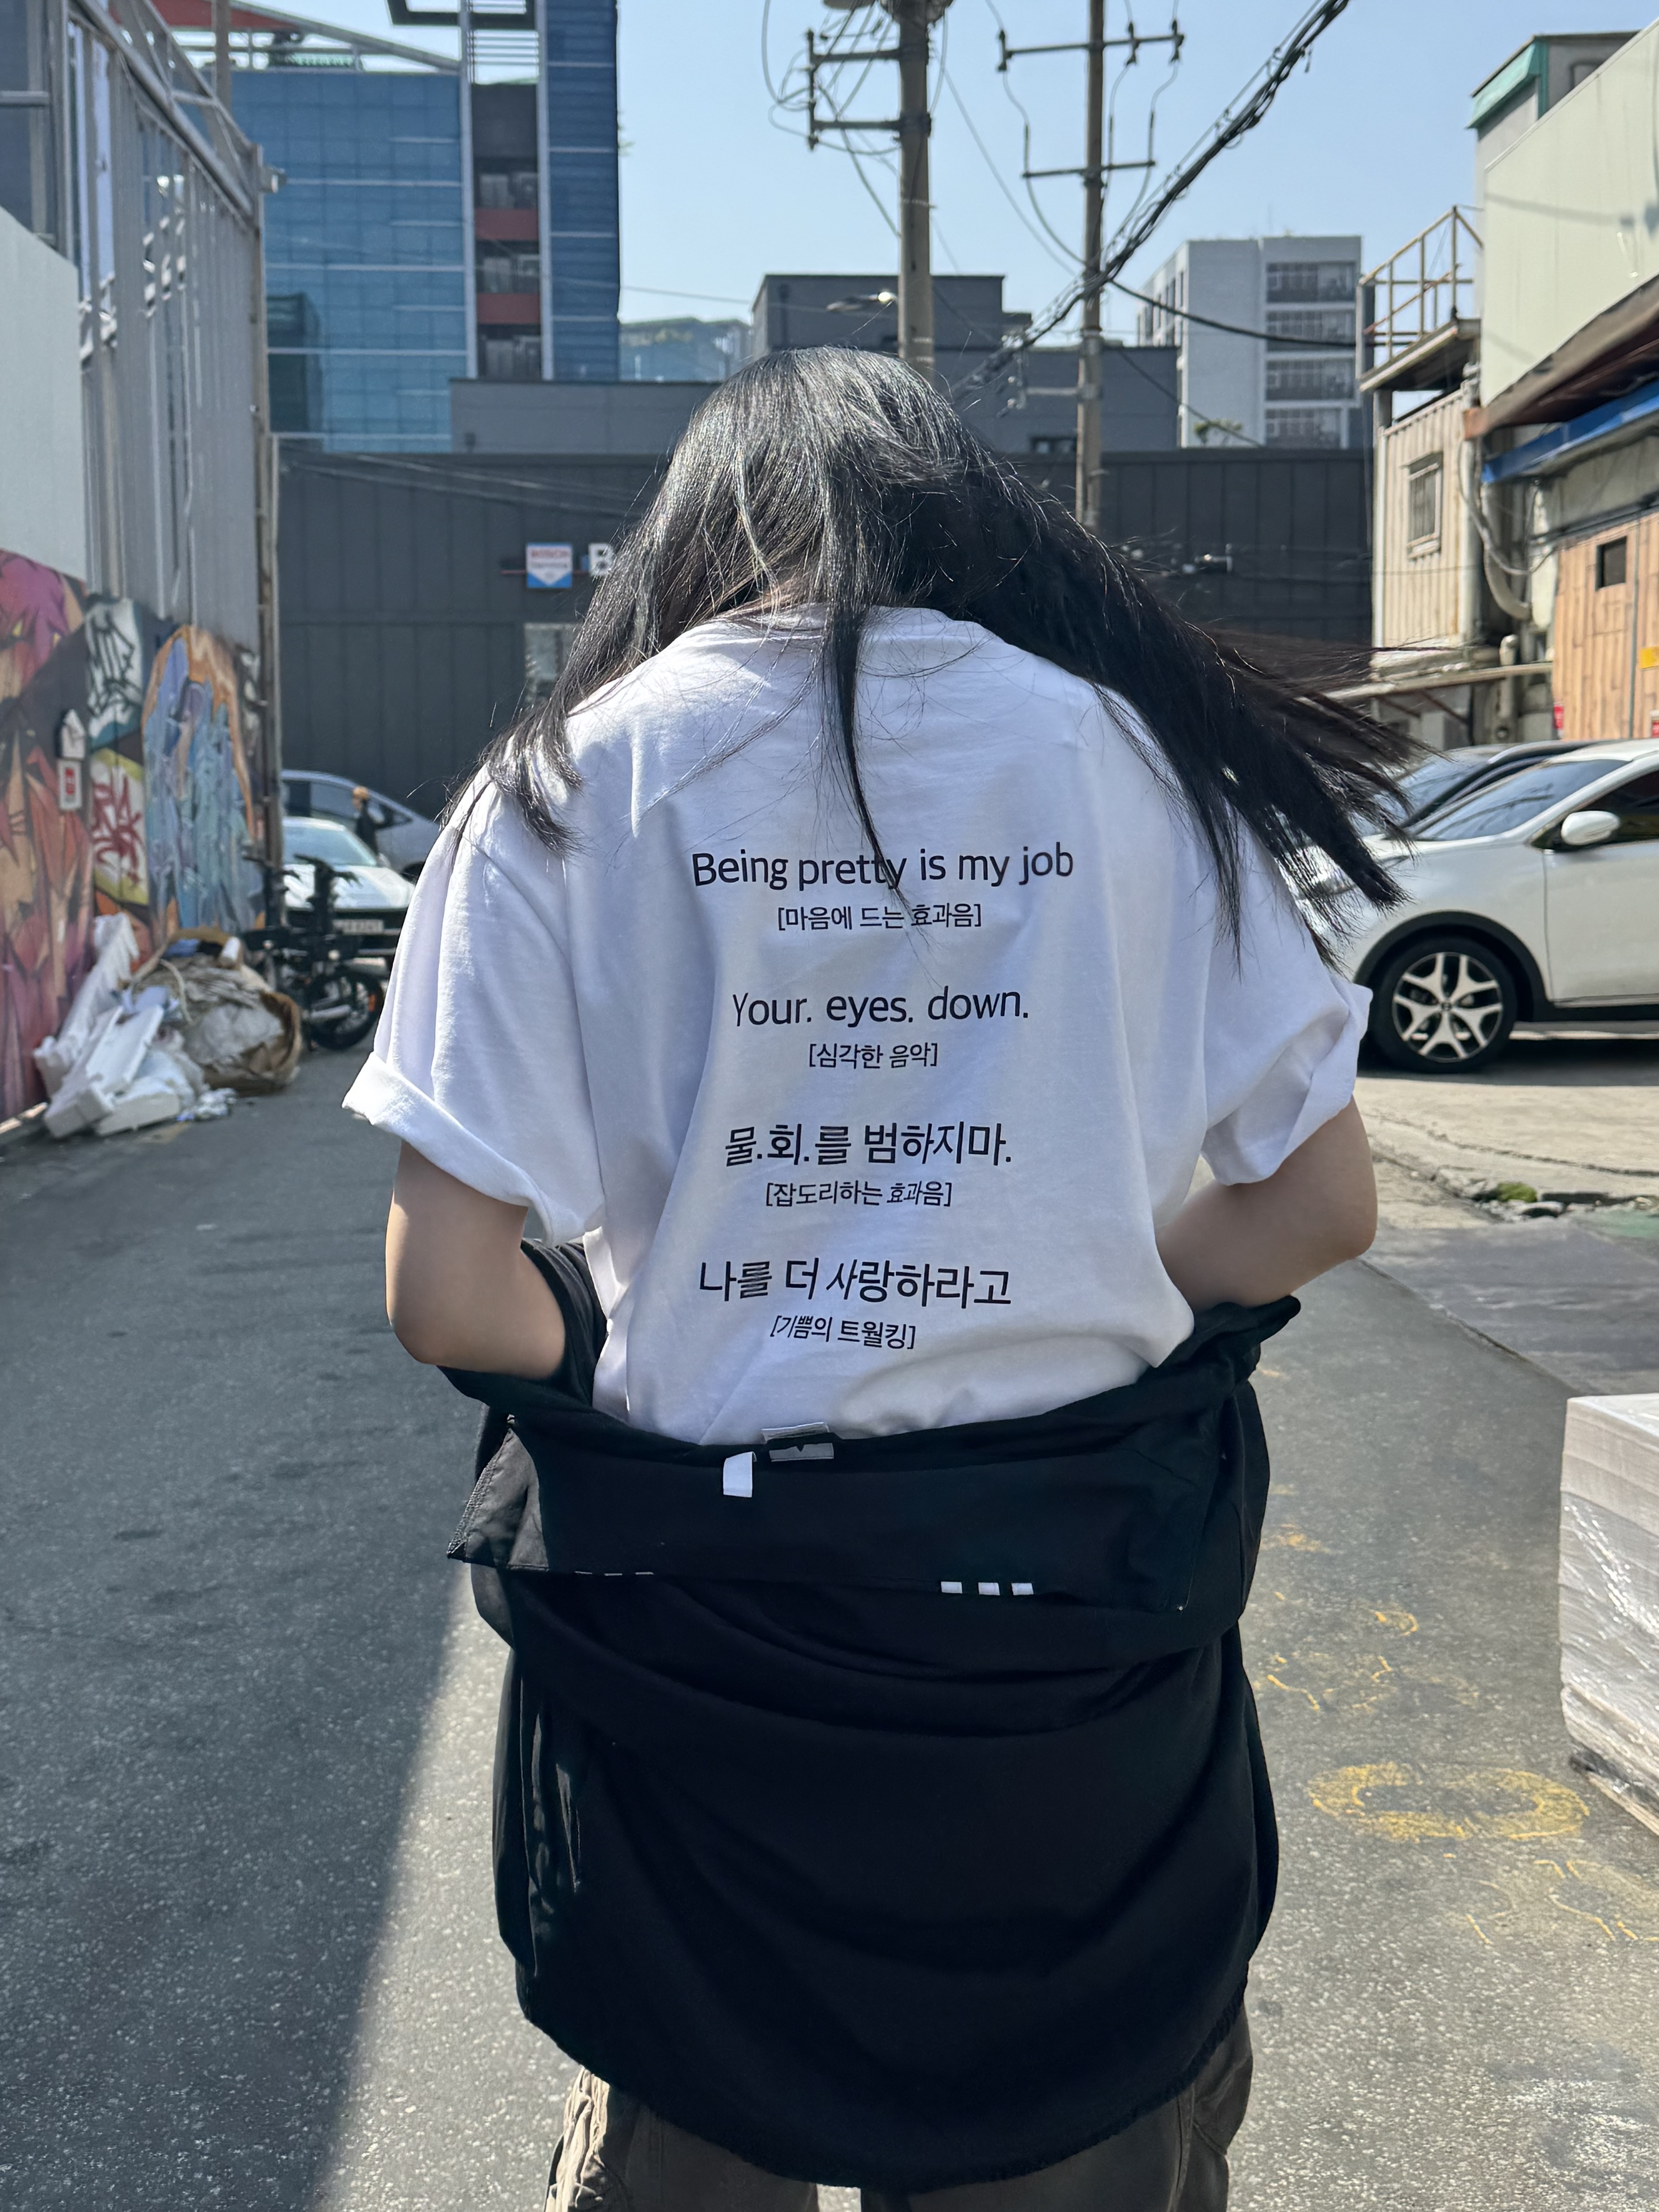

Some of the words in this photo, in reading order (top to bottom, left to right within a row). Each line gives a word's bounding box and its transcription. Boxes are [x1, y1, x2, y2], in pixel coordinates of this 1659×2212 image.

[693, 849, 788, 890] Being
[799, 855, 908, 890] pretty
[920, 848, 946, 881] is
[959, 855, 1010, 887] my
[1019, 842, 1073, 885] job
[778, 906, 852, 931] [마음에
[860, 906, 905, 929] 드는
[910, 903, 981, 929] 효과음]
[733, 993, 812, 1026] Your.
[826, 995, 913, 1028] eyes.
[928, 986, 1028, 1023] down.
[809, 1043, 884, 1069] [심각한
[890, 1042, 938, 1067] 음악]
[725, 1124, 852, 1167] 물.회.를
[864, 1121, 1011, 1166] 범하지마.
[766, 1180, 883, 1207] [잡도리하는
[886, 1181, 952, 1207] 효과음]
[700, 1261, 772, 1302] 나를
[785, 1258, 819, 1300] 더
[826, 1259, 1011, 1309] 사랑하라고
[770, 1316, 833, 1342] [기쁨의
[837, 1320, 916, 1350] 트월킹]
